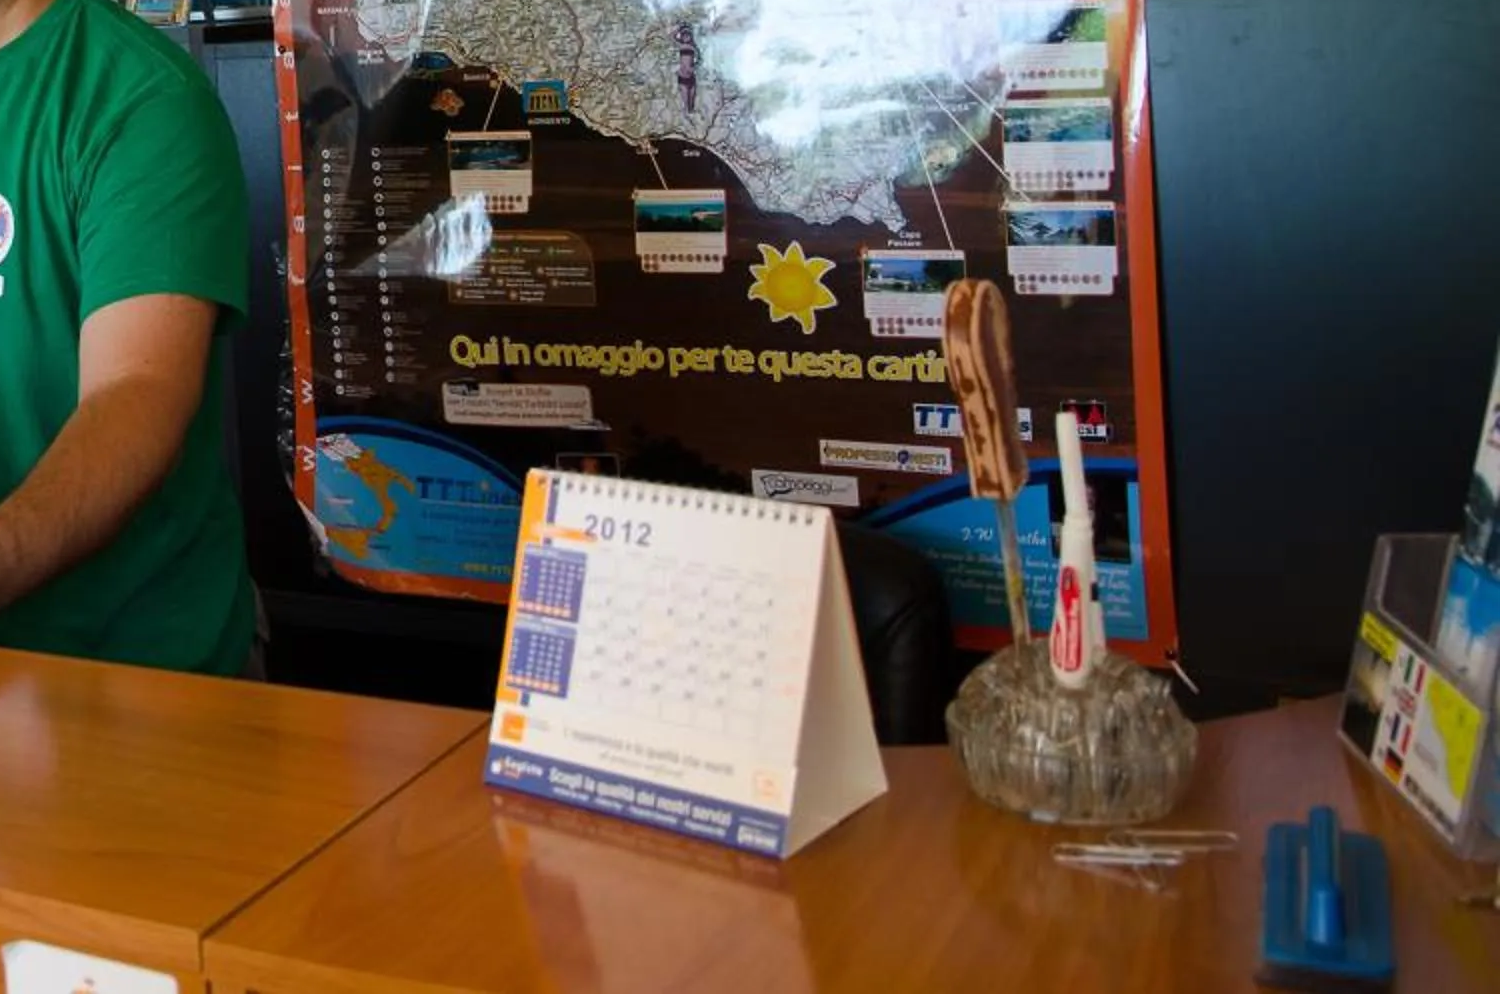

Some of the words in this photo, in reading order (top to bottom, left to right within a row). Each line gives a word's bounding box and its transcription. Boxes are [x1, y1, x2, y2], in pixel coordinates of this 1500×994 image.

[449, 334, 499, 368] Qui
[502, 336, 531, 367] in
[533, 339, 665, 376] omaggio
[669, 346, 722, 378] per
[721, 344, 756, 375] te
[757, 350, 864, 383] questa
[867, 350, 949, 384] carti
[915, 406, 960, 428] TT
[584, 514, 652, 547] 2012
